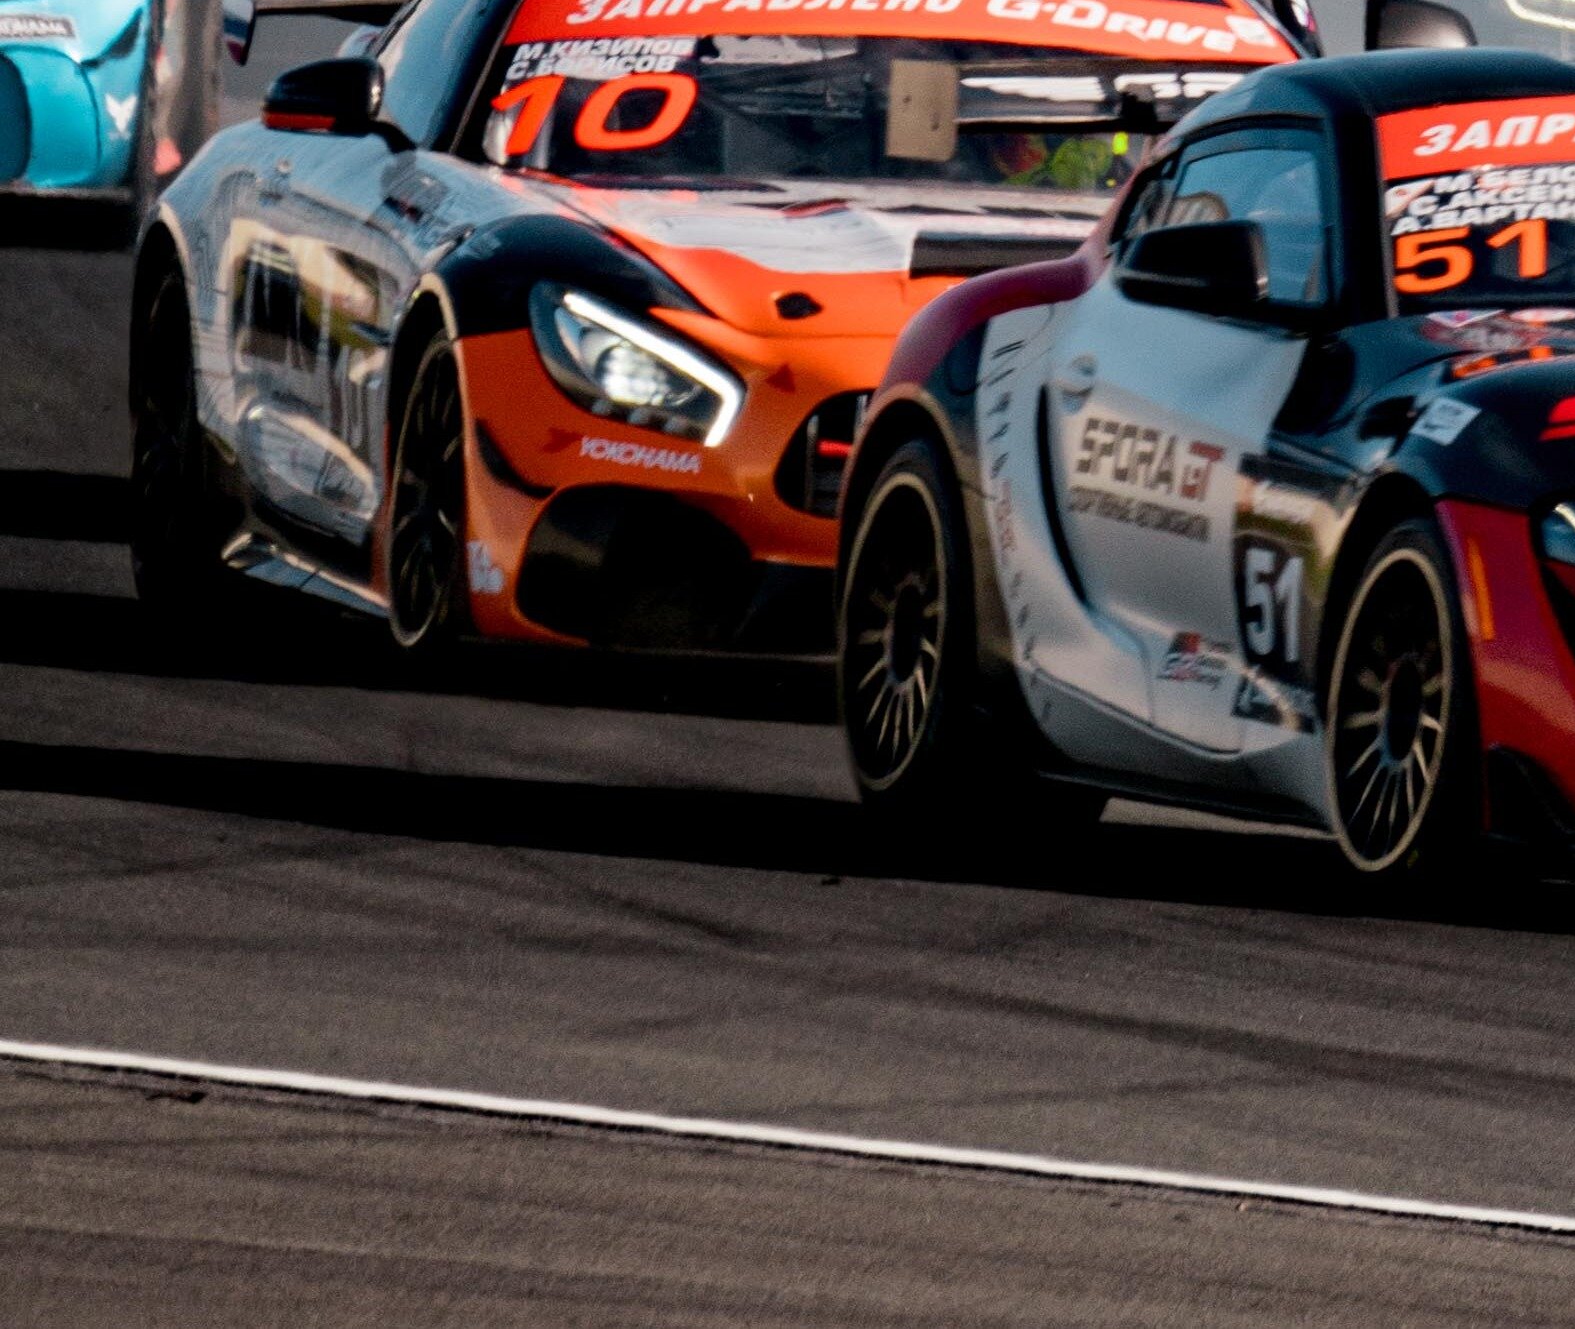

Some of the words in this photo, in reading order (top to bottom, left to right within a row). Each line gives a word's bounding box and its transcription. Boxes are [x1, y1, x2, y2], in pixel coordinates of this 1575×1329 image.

[491, 73, 698, 157] 10
[1392, 219, 1549, 295] 51
[580, 435, 701, 474] YOKOHAMA
[1244, 548, 1304, 663] 51
